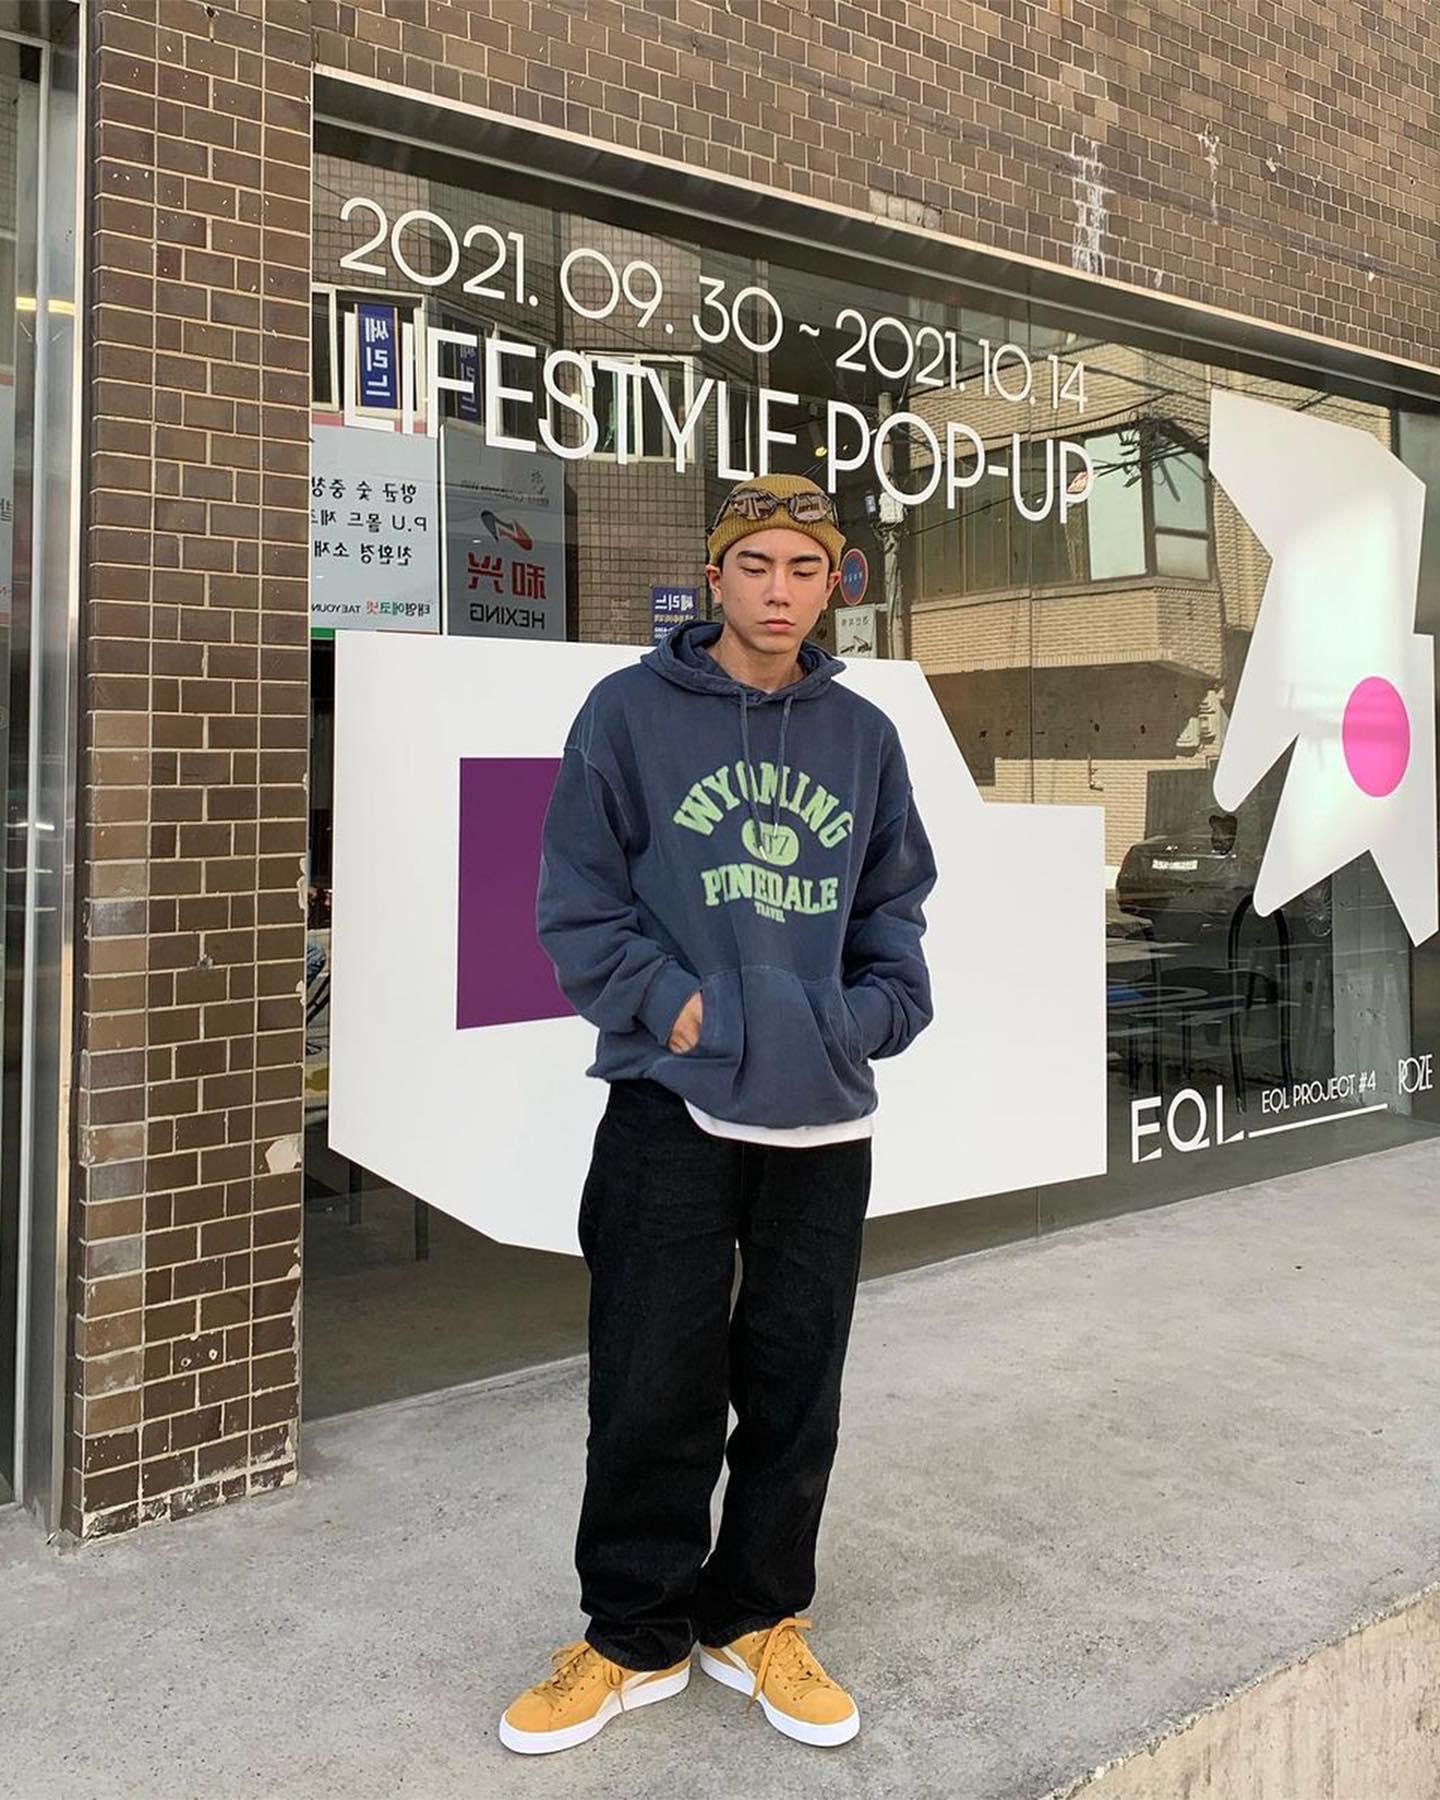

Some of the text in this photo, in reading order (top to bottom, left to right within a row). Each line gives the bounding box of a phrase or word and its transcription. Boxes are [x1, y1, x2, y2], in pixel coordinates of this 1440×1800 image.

[339, 197, 539, 307] 2021.
[559, 248, 674, 334] 09.
[692, 275, 784, 353] 30
[1047, 354, 1088, 414] 14
[344, 311, 1094, 524] LIFESTYLE POP-UP
[673, 760, 854, 849] WYOMING
[701, 863, 838, 915] PINEDALE
[1131, 1084, 1245, 1164] EQL
[1262, 1070, 1377, 1115] EQL PROJECT #4
